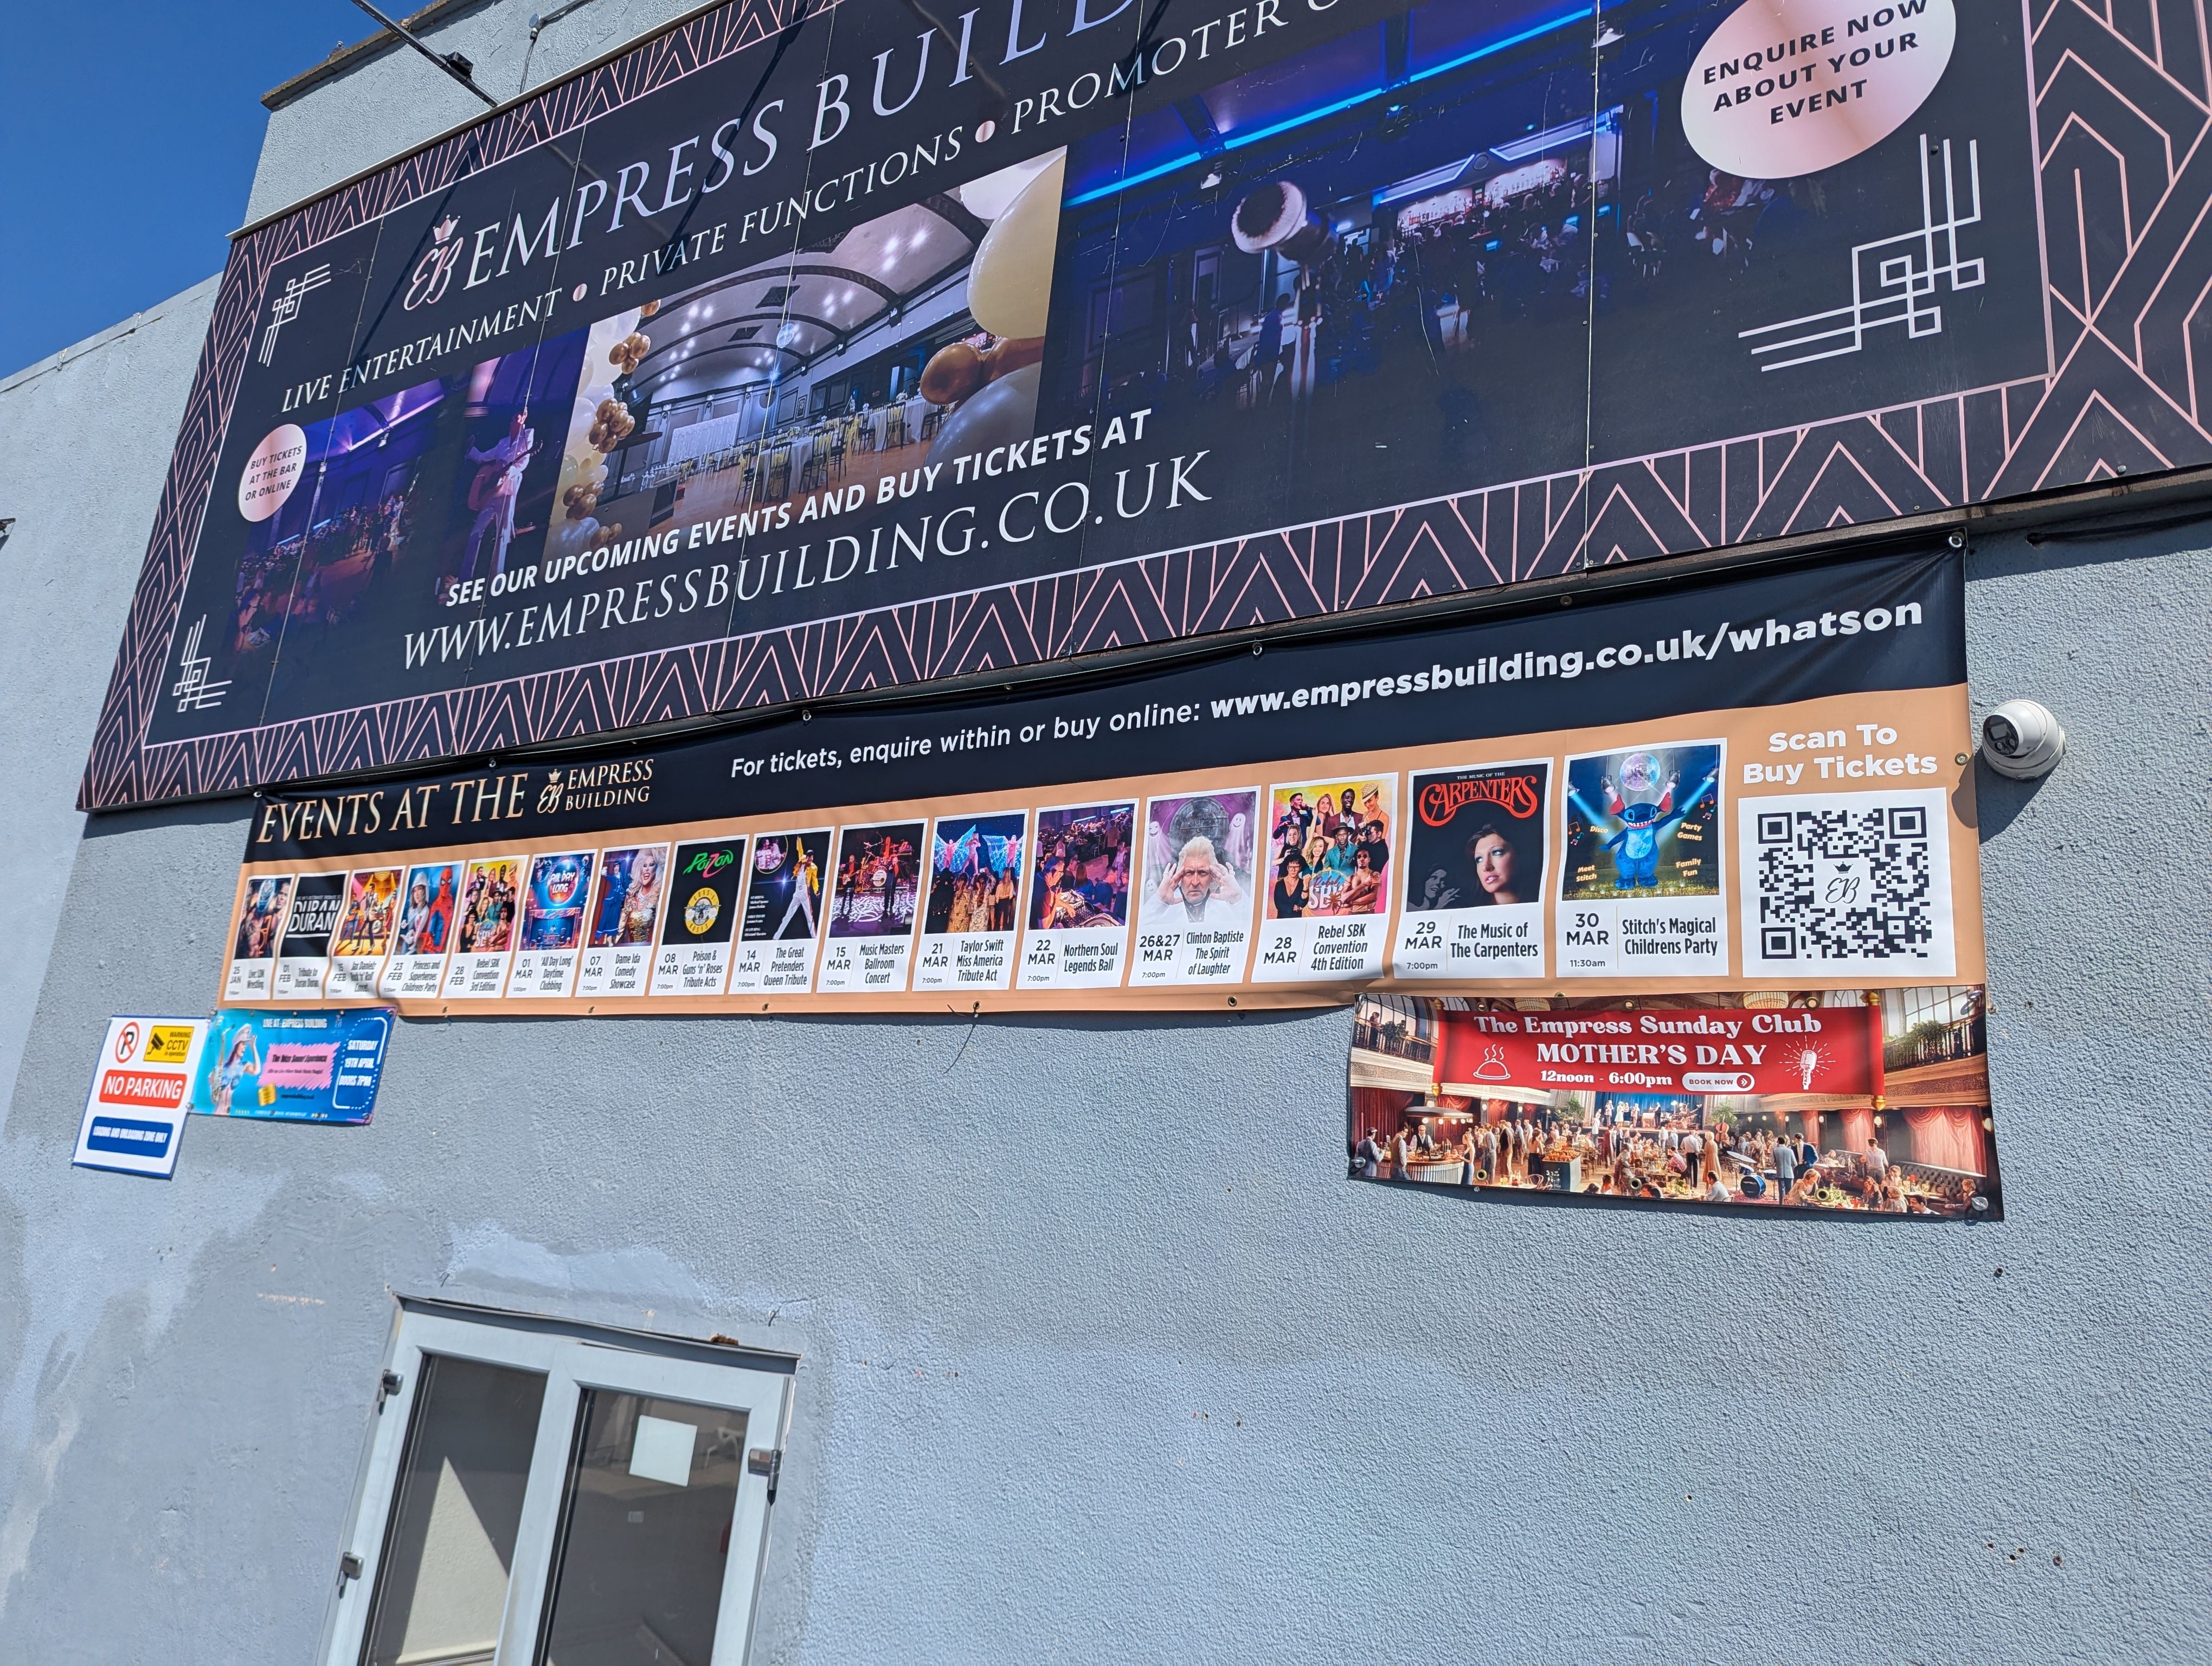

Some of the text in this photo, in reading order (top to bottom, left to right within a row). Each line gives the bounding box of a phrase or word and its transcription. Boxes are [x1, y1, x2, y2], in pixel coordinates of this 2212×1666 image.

[1704, 0, 1927, 85] ENQUIRE NOW
[1713, 32, 1919, 112] ABOUT YOUR
[1771, 79, 1867, 125] EVENT
[462, 99, 784, 291] EMPRESS
[280, 0, 1289, 413] LIVE ENTERTAINMENT PRIVATE FUNCTIONS PROMOTER
[250, 445, 303, 470] BUY TICKETS
[249, 463, 297, 485] AT THE BAR
[245, 479, 291, 501] OR ONLINE
[445, 408, 1152, 608] SEE OUR UPCOMING EVENTS AND BUY TICKETS AT
[404, 450, 1212, 670] WWW.EMPRESSBUILDING.CO.UK
[731, 601, 1923, 778] For tickets, enquire within or buy online: www.empressbuilding.co.uk/whatson
[1768, 723, 1898, 753] Scan To
[568, 758, 654, 791] EMPRESS
[1743, 753, 1938, 785] Buy Tickets
[565, 785, 651, 811] BUILDING
[1419, 776, 1538, 826] CARPENTERS
[256, 773, 529, 843] EVENTS AT THE
[1681, 822, 1702, 832] Party
[1677, 832, 1702, 841] Games
[1578, 864, 1595, 873] Meet
[1675, 858, 1701, 868] Family
[1576, 873, 1597, 882] Stitch
[288, 912, 336, 932] DURAN
[1575, 913, 1599, 928] 30
[1622, 917, 1716, 935] Stitch's Magical
[1318, 923, 1366, 939] Rebel SBK
[1416, 921, 1436, 934] 29
[1457, 922, 1528, 939] The Music of
[1139, 934, 1181, 947] 26&27
[1186, 930, 1244, 945] Clinton Baptiste
[1274, 937, 1292, 949] 28
[1405, 936, 1443, 950] MAR
[1566, 931, 1609, 946] MAR
[859, 944, 904, 956] Music Masters
[931, 943, 943, 954] 21
[961, 939, 1004, 953] Taylor Swift
[1036, 939, 1051, 951] 22
[1064, 943, 1118, 957] Northern Soul
[1313, 940, 1368, 956] Convention
[1450, 941, 1539, 960] The Carpenters
[1625, 939, 1718, 957] Childrens Party
[665, 953, 676, 963] 08
[692, 951, 711, 961] Poison
[747, 950, 756, 960] 14
[776, 947, 804, 959] The Great
[836, 947, 846, 957] 15
[1143, 949, 1173, 962] MAR
[1195, 946, 1229, 960] The Spirit
[1263, 951, 1297, 964] MAR
[522, 959, 531, 967] 01
[590, 956, 601, 965] 07
[827, 959, 851, 970] MAR
[864, 958, 895, 970] Ballroom
[922, 956, 948, 967] MAR
[956, 954, 1003, 967] Miss America
[1027, 953, 1056, 965] MAR
[1310, 956, 1364, 971] 4th Edition
[1570, 959, 1605, 967] 11:30am
[455, 966, 465, 975] 28
[584, 967, 603, 977] MAR
[658, 965, 678, 975] MAR
[683, 964, 723, 975] Guns Roses
[738, 962, 760, 972] MAR
[770, 961, 805, 972] Pretenders
[1064, 959, 1114, 974] Legends Ball
[1188, 962, 1231, 976] of Laughter
[1406, 962, 1438, 971] 7:00pm
[387, 972, 402, 981] FEB
[515, 970, 533, 978] MAR
[763, 974, 807, 986] Queen Tribute
[865, 972, 891, 984] Concert
[957, 969, 998, 982] Tribute Act
[449, 977, 465, 985] FEB
[609, 979, 635, 989] Showcase
[683, 977, 717, 988] Tribute Acts
[1473, 1013, 1822, 1039] The Empress Sunday Club
[166, 1040, 188, 1050] CCTV
[347, 1040, 378, 1051] SATURDAY
[1536, 1043, 1767, 1065] MOTHER'S DAY
[358, 1058, 375, 1069] APRIL
[338, 1075, 356, 1086] DOORS
[1540, 1070, 1673, 1088] 12noon 6:00pm
[1714, 1078, 1734, 1086] NOW
[104, 1075, 183, 1100] NO PARKING
